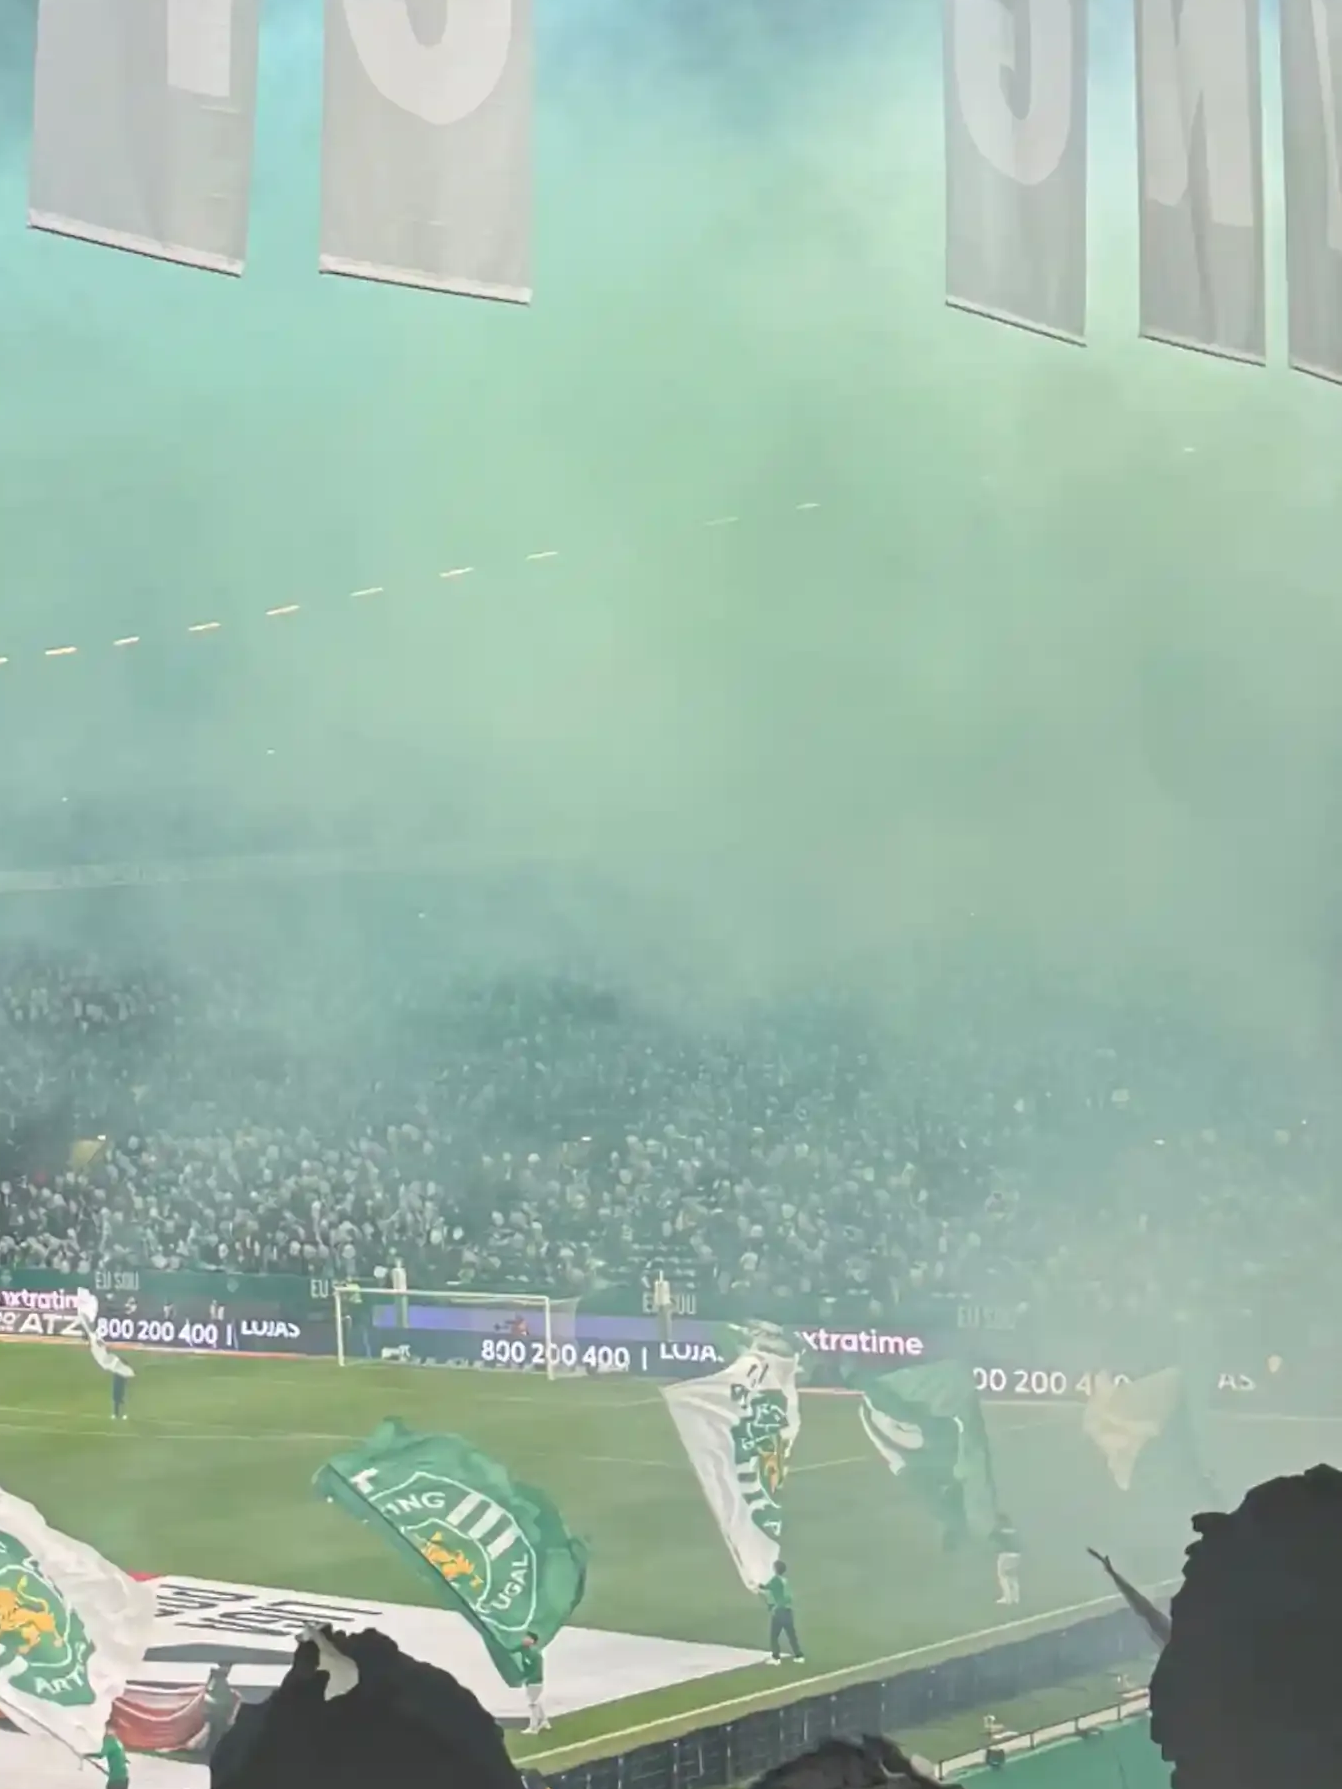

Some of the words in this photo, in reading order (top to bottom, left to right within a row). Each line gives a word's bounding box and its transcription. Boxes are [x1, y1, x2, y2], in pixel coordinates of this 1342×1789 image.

[96, 1317, 134, 1340] 800
[137, 1320, 175, 1342] 200
[177, 1321, 219, 1345] 400
[481, 1339, 525, 1363] 800
[582, 1344, 630, 1367] 400
[1012, 1369, 1068, 1395] 200
